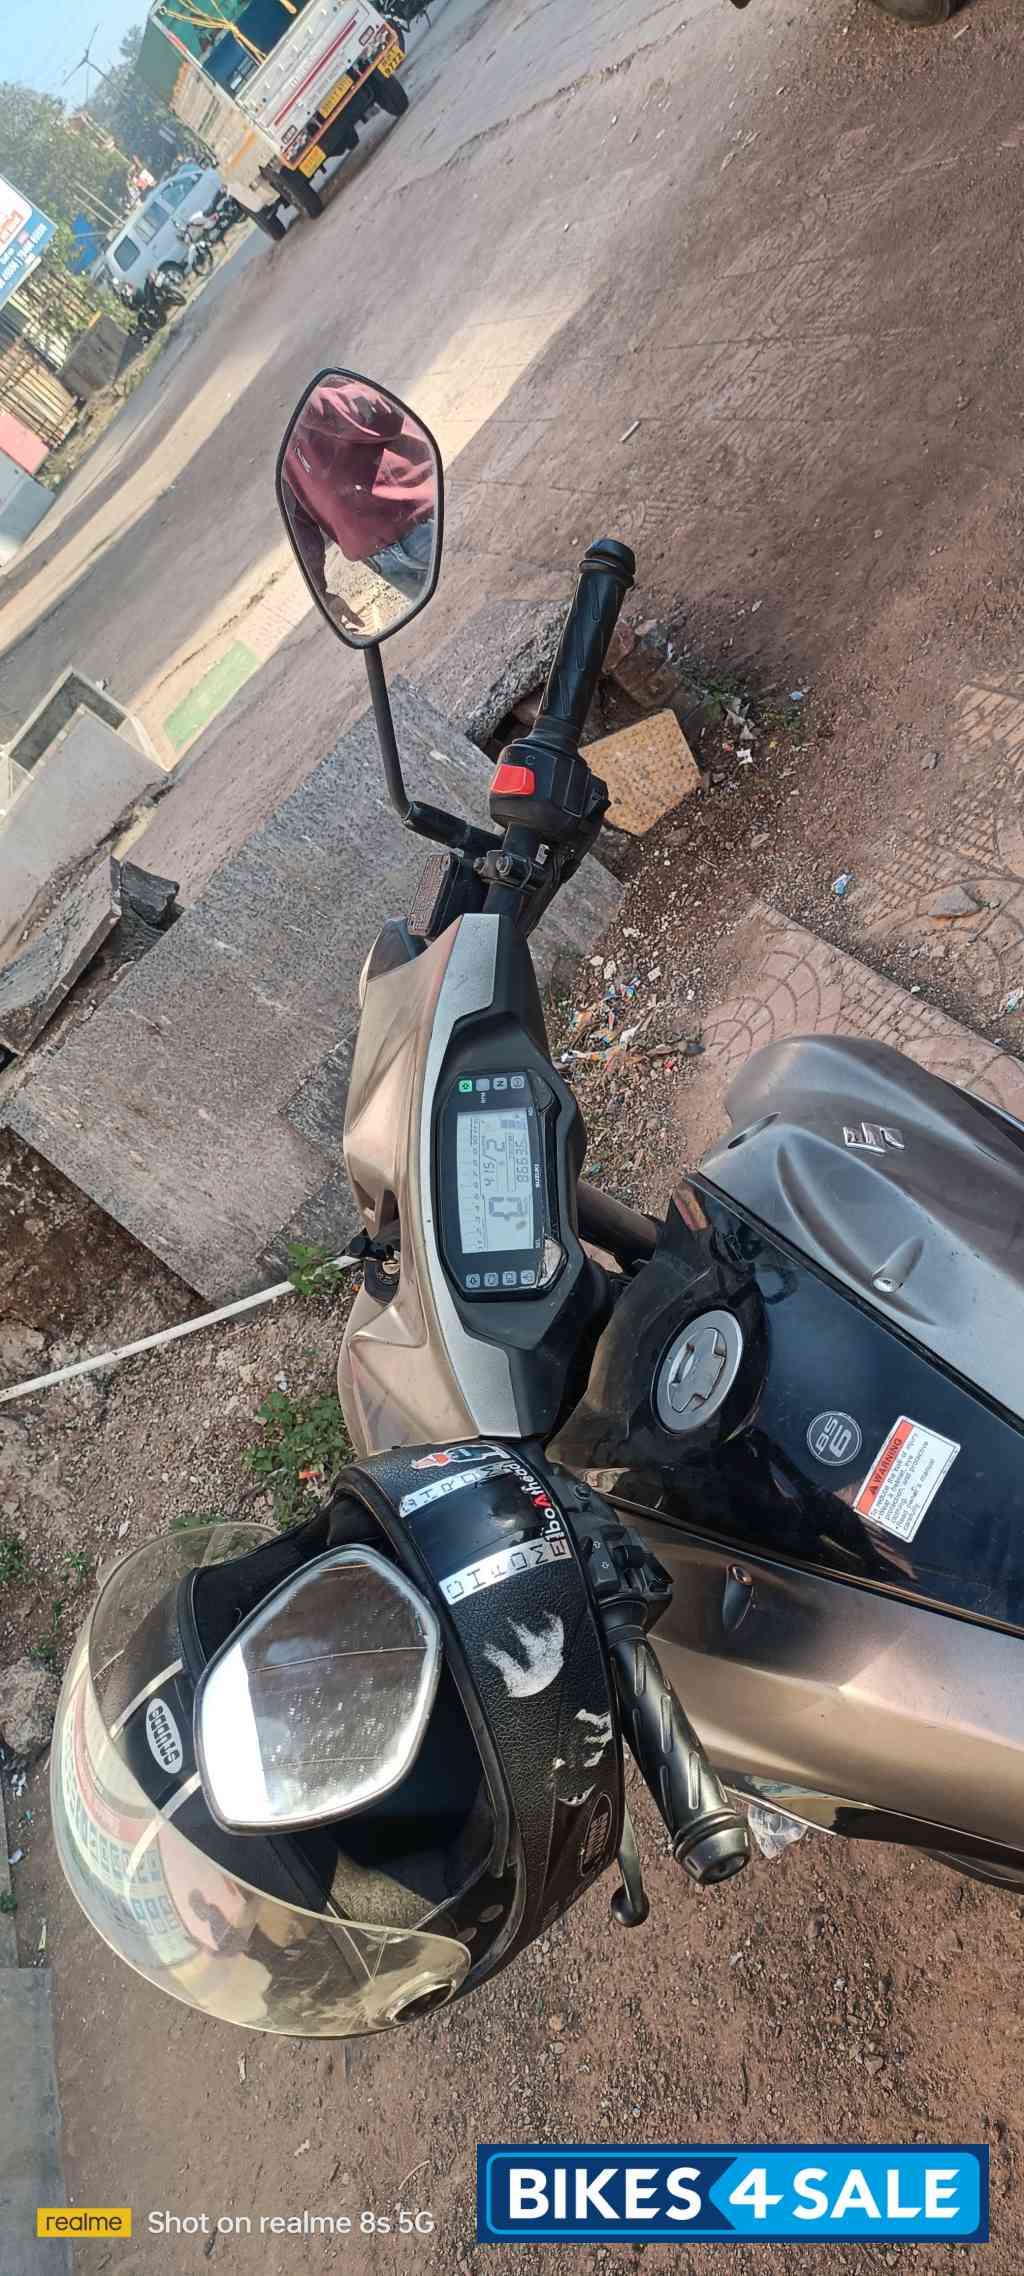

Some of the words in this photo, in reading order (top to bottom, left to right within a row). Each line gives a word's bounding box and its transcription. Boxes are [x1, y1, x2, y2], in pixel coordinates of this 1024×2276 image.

[815, 1417, 838, 1456] BS
[829, 1424, 851, 1457] 6
[874, 1438, 902, 1483] WARNING
[148, 1705, 180, 1766] STUDDS
